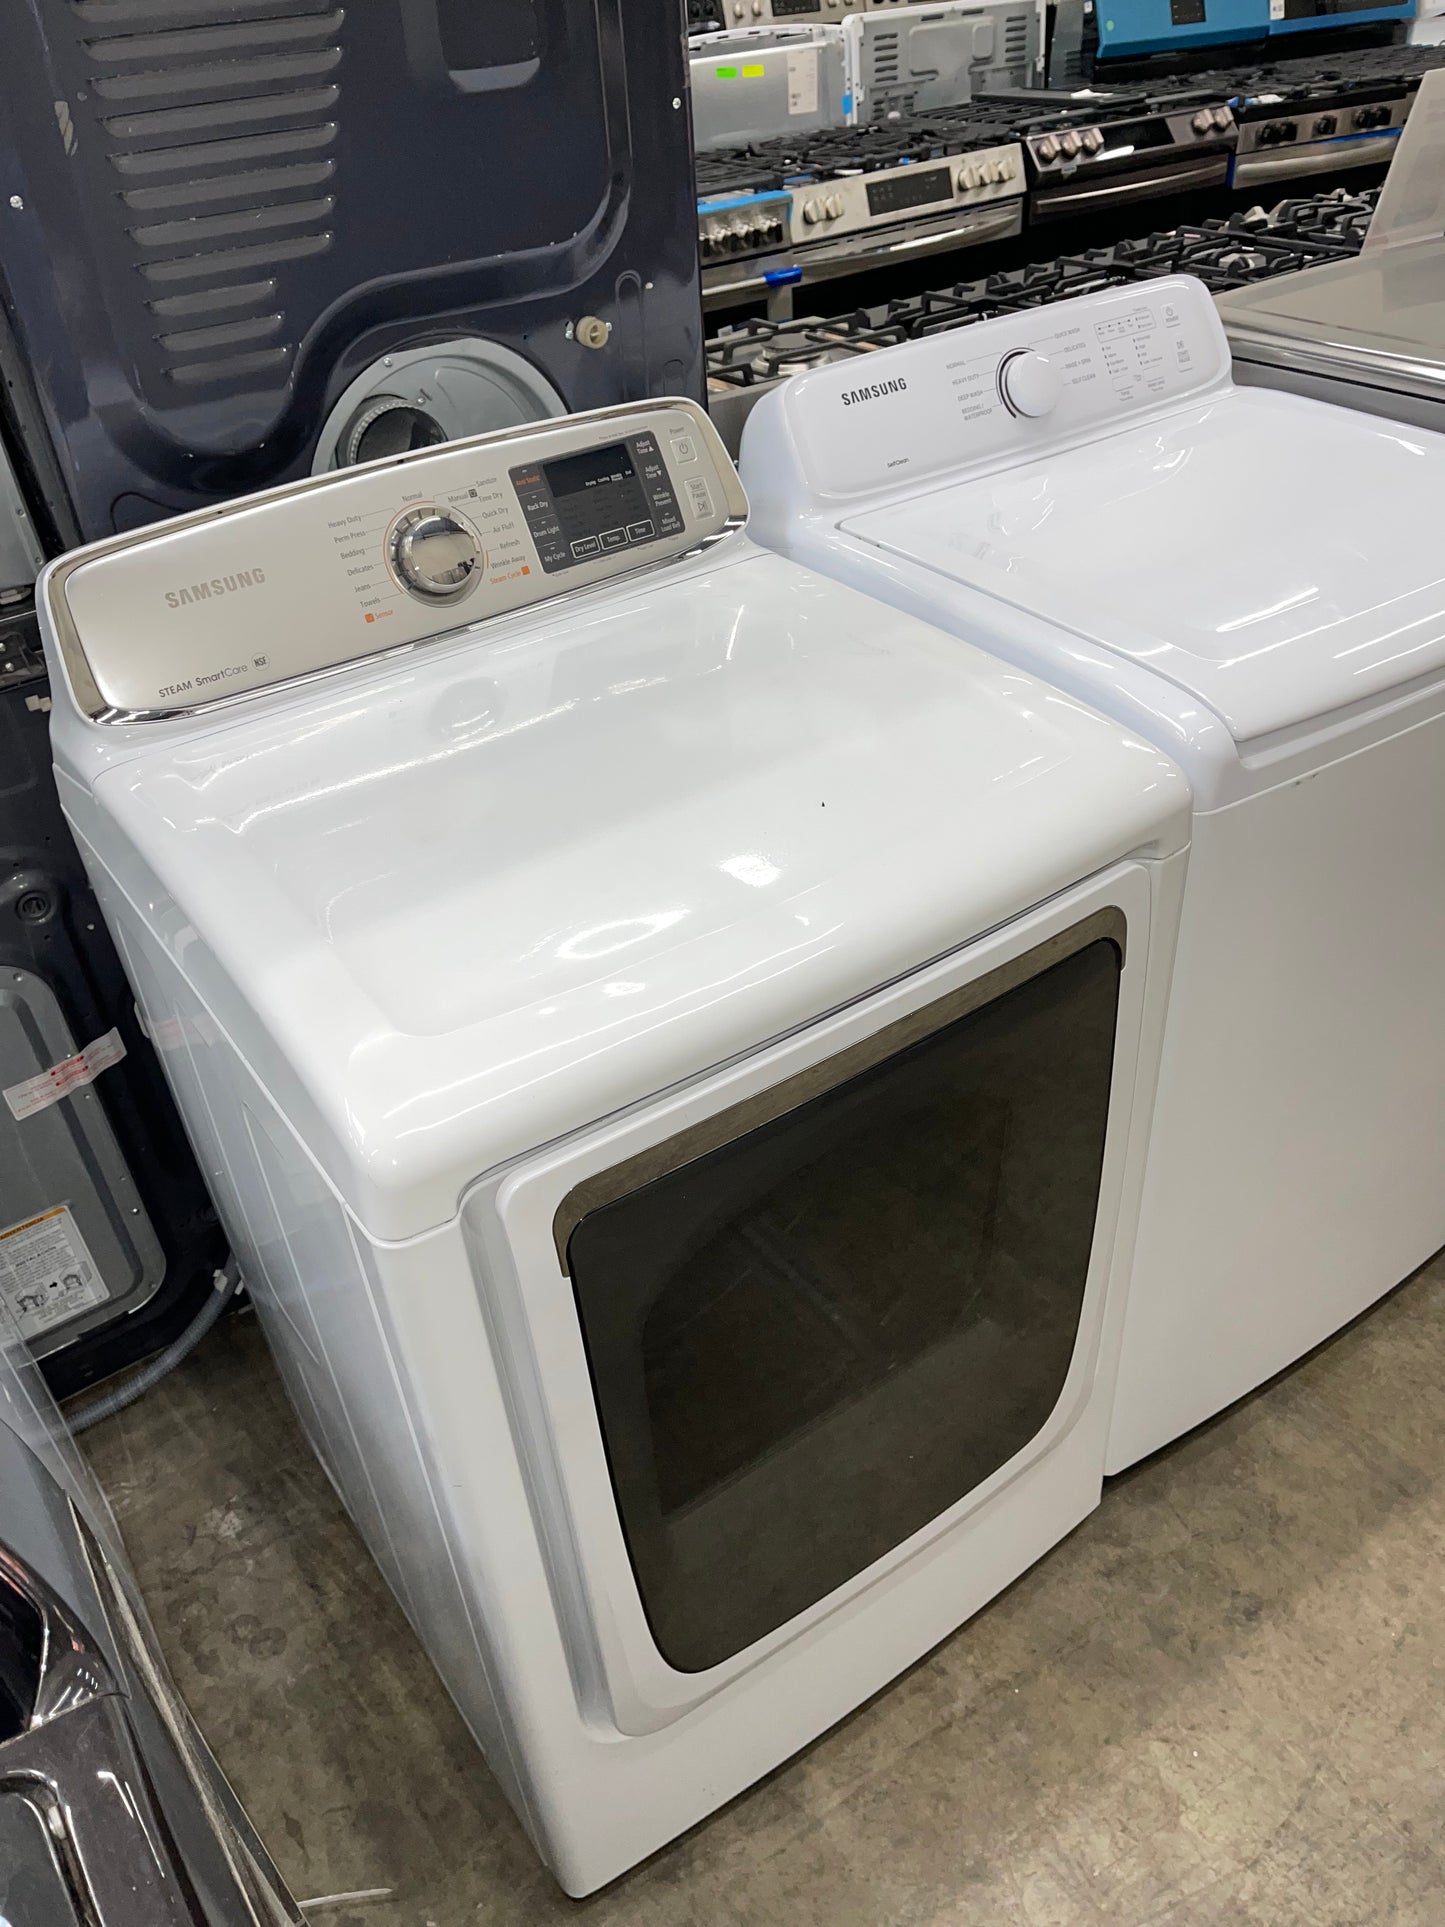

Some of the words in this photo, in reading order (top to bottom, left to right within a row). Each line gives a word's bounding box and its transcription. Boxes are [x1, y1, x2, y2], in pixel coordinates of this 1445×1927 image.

[841, 377, 907, 406] SAMSUNG
[636, 439, 651, 449] Adjust
[645, 464, 660, 474] Adjust
[401, 491, 423, 504] Normal
[447, 491, 469, 503] Manual
[478, 493, 491, 503] Time
[491, 491, 503, 502] Dry
[527, 503, 538, 511] Rack
[538, 501, 549, 510] Dry
[481, 509, 497, 520] Quick
[497, 506, 509, 517] Dry
[328, 517, 346, 530] Heavy
[346, 514, 362, 527] Duty
[333, 533, 350, 545] Perm
[350, 529, 367, 541] Press
[533, 529, 546, 539] Drum
[546, 524, 560, 535] Light
[499, 538, 521, 550] Refresh
[574, 544, 584, 554] Dry
[584, 540, 596, 551] Level
[340, 548, 366, 560] Bedding
[544, 554, 552, 563] My
[552, 550, 566, 561] Cycle
[490, 559, 509, 570] Wrinkle
[508, 554, 526, 566] Away
[347, 563, 374, 577] Delicates
[489, 574, 507, 584] Steam
[507, 569, 522, 580] Cycle
[164, 568, 266, 609] SAMSUNG
[354, 582, 372, 594] Jeans
[360, 596, 382, 608] Towels
[374, 608, 394, 620] Sensor
[253, 655, 267, 667] NSF
[158, 680, 193, 698] STEAM
[195, 664, 248, 686] SmartCare
